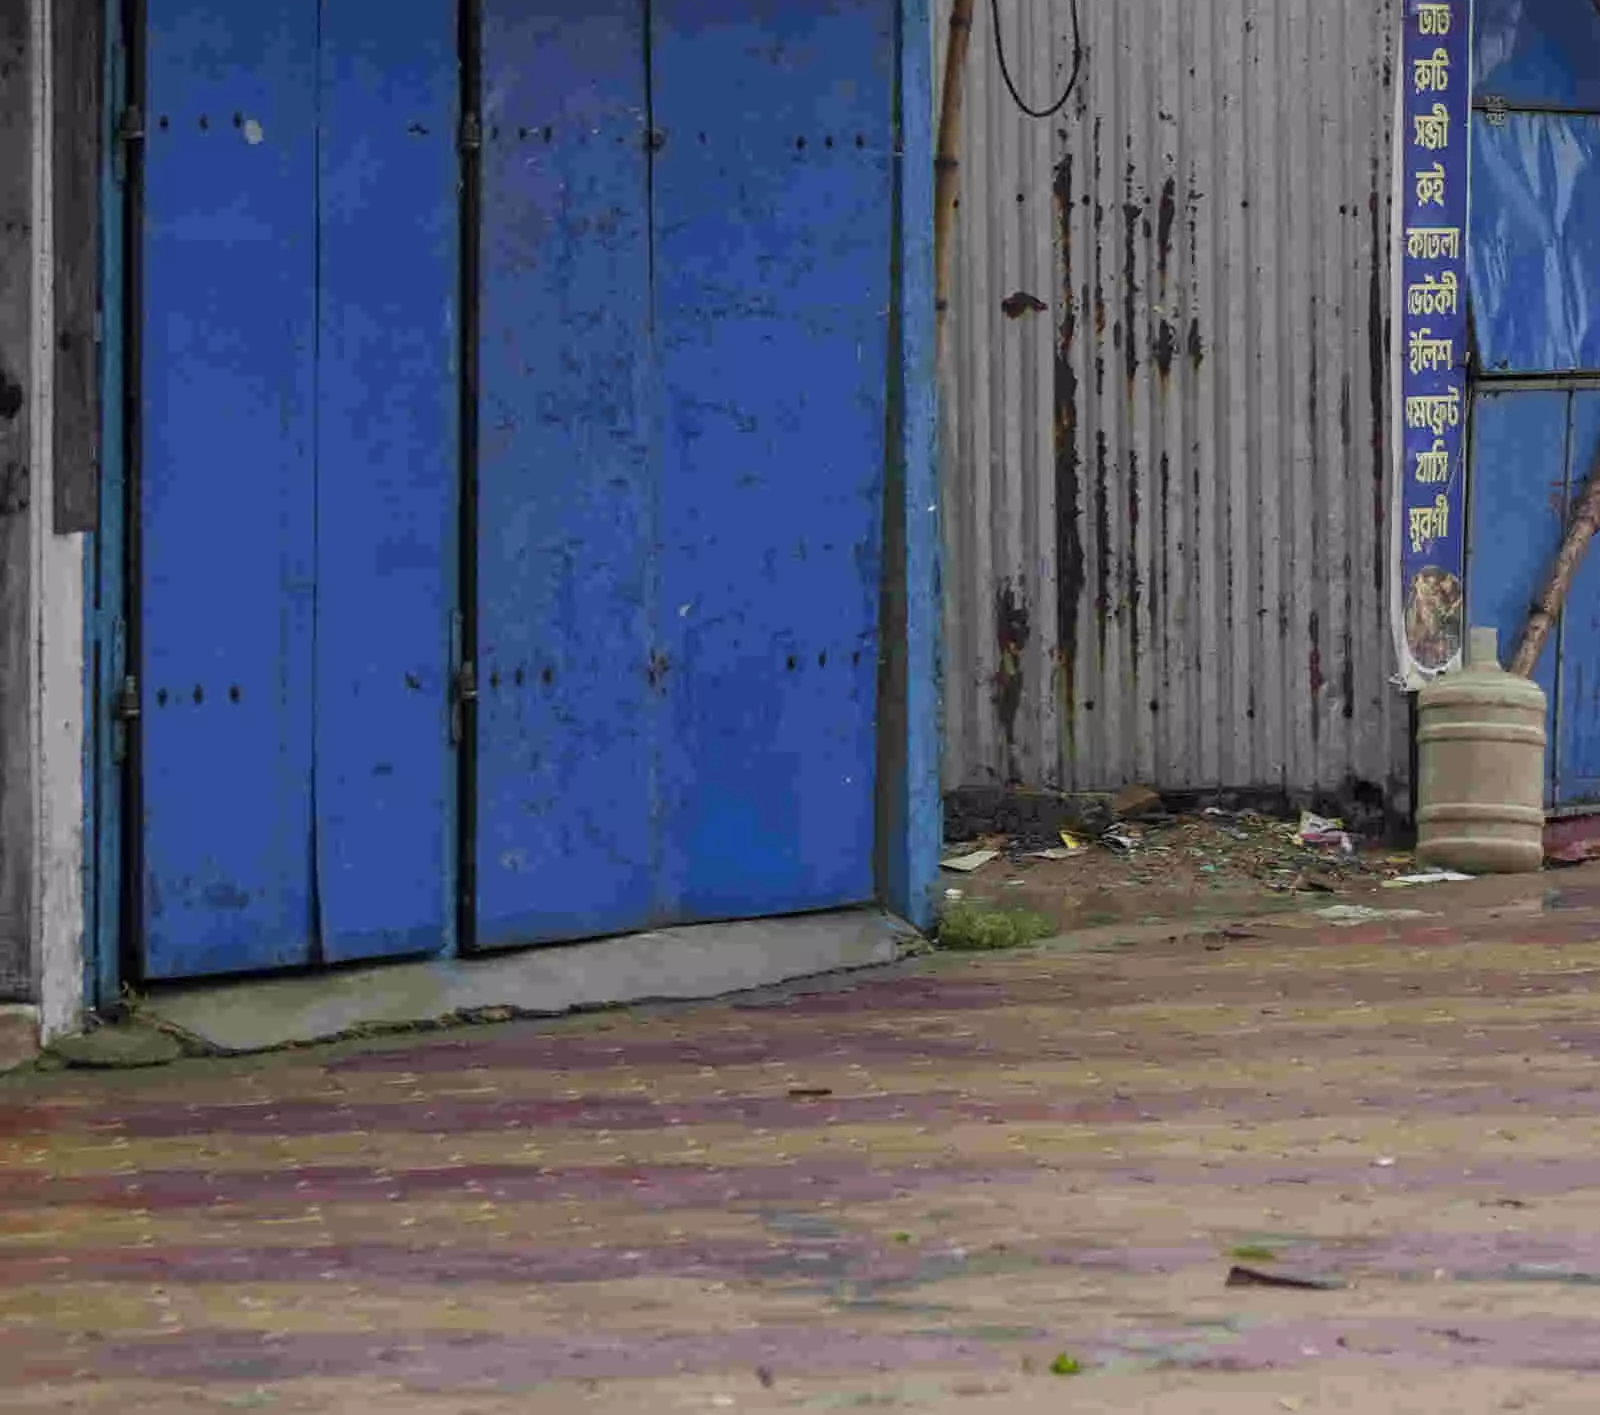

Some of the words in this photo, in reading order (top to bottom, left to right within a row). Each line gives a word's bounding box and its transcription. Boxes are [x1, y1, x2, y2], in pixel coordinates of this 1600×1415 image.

[1417, 2, 1451, 37] ভাত
[1414, 47, 1449, 94] রুটি
[1416, 161, 1446, 206] রুই
[1406, 227, 1460, 260] কাতলা
[1408, 271, 1458, 317] ভেটকী
[1409, 327, 1453, 374] ইলিশ
[1409, 493, 1449, 554] মুরগী
